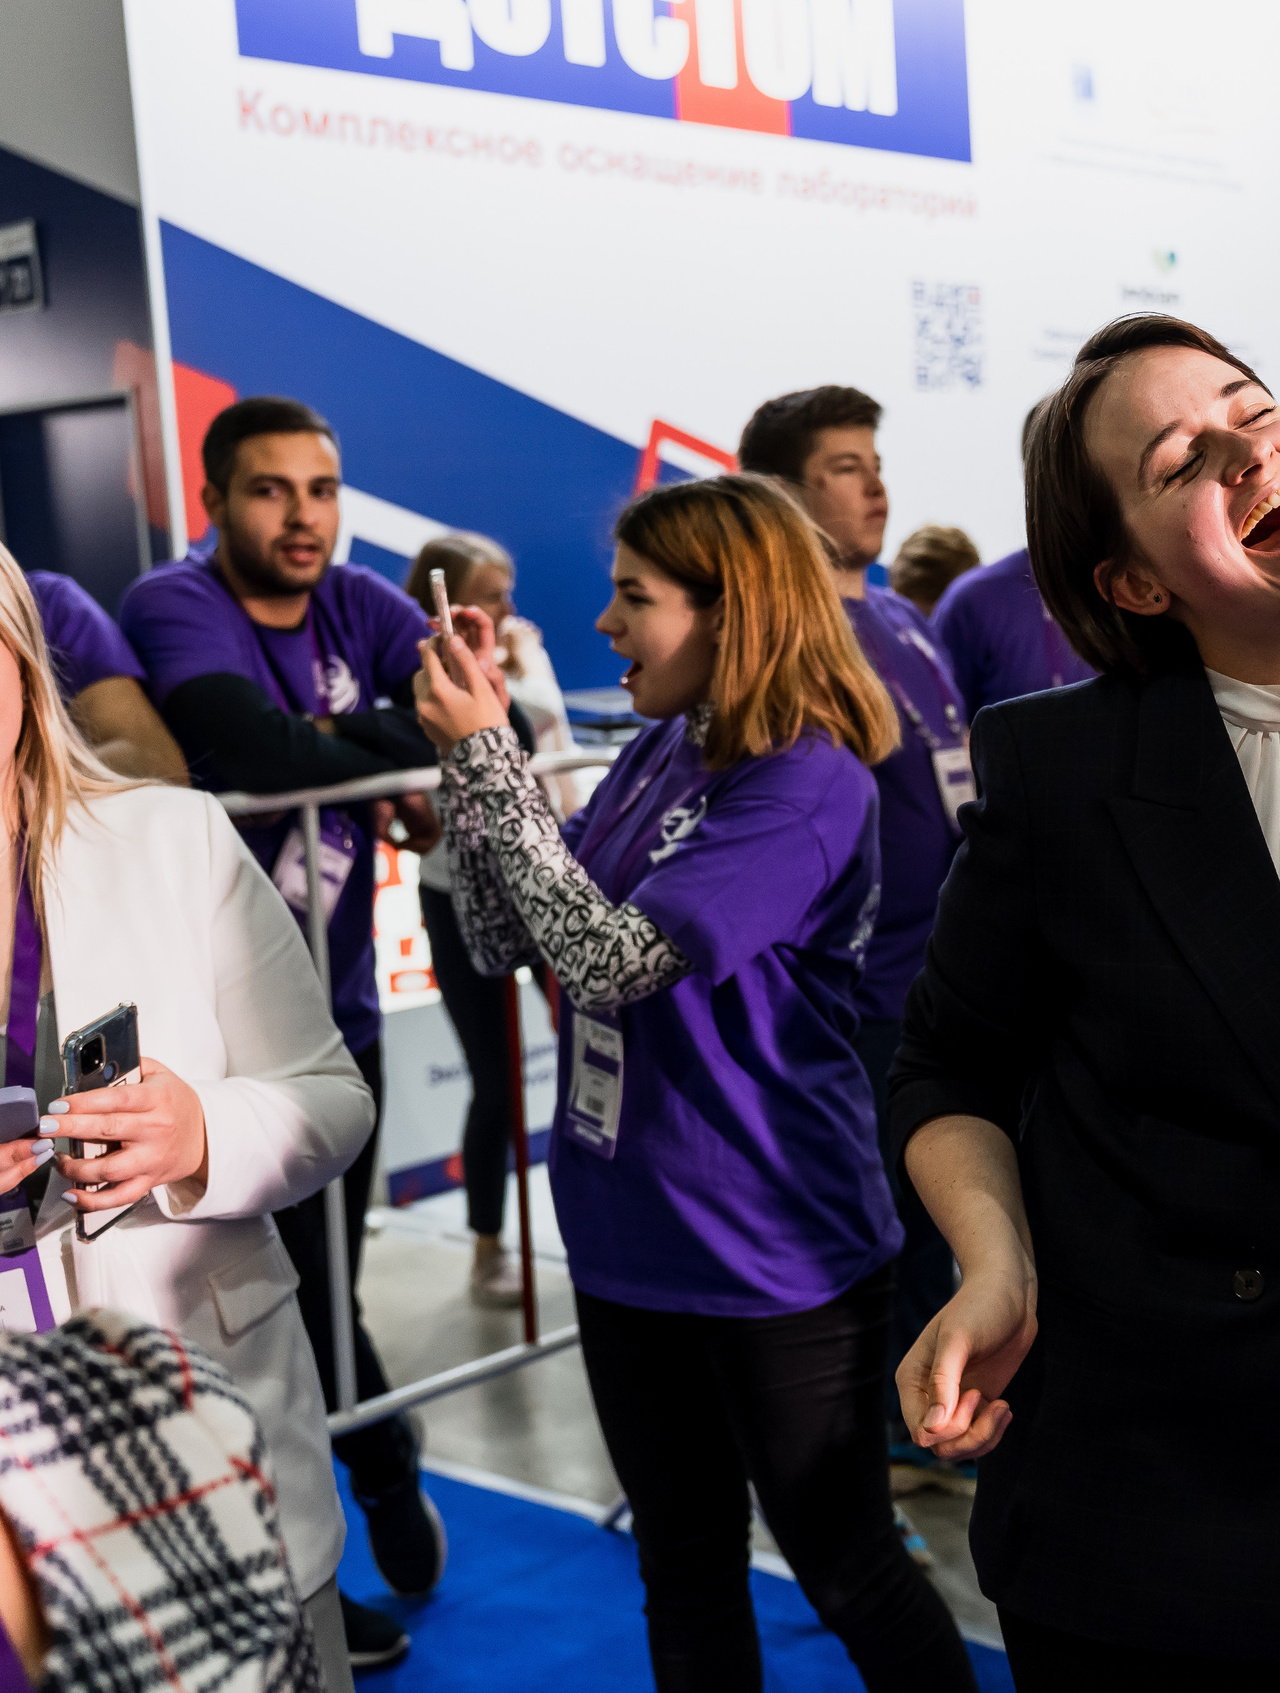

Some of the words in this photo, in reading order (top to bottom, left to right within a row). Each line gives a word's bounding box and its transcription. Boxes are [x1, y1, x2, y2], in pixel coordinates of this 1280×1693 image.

[236, 88, 542, 168] Комплексное
[557, 142, 763, 196] оснащение
[776, 165, 979, 220] лабораторий
